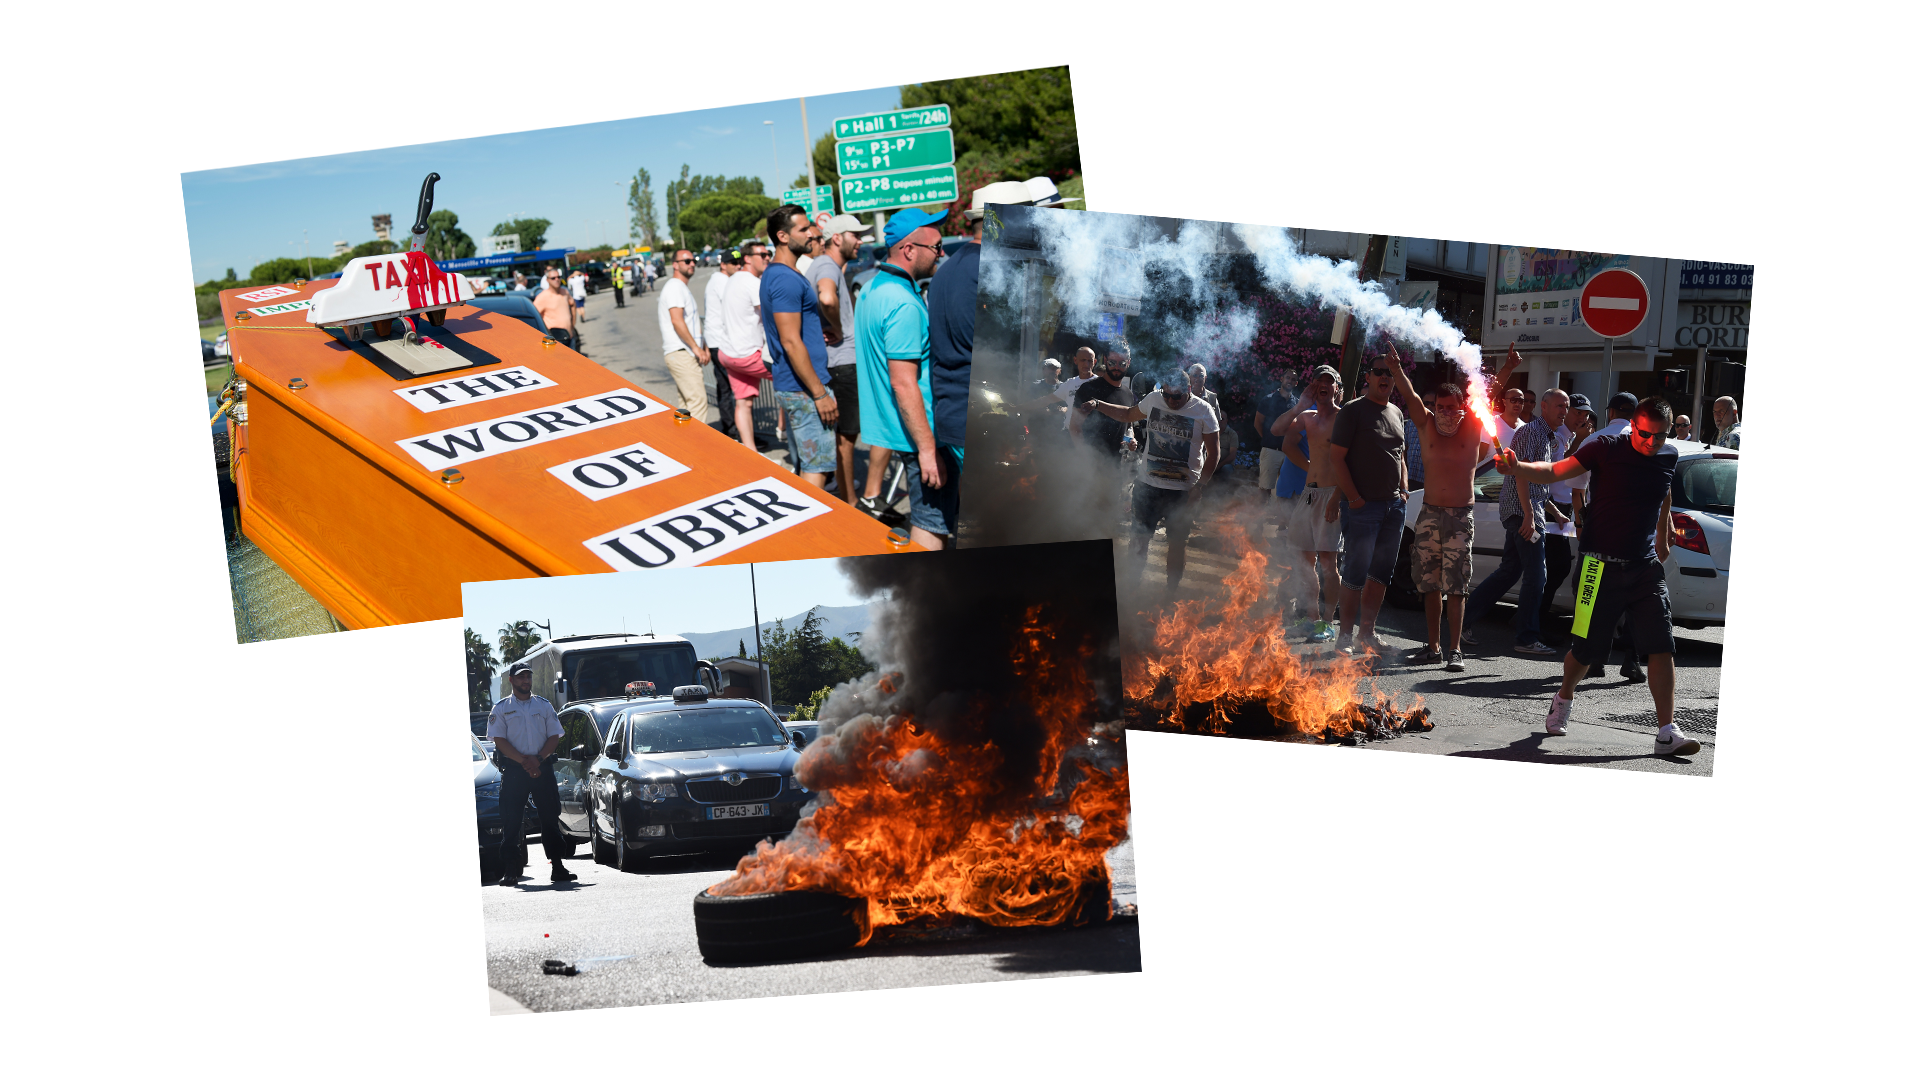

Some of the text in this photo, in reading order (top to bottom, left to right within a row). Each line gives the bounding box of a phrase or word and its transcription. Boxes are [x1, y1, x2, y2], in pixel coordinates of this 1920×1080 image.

[852, 116, 884, 133] Hall
[889, 115, 897, 129] 1
[870, 137, 915, 155] P3-P7
[872, 154, 890, 169] P1
[845, 177, 891, 195] P2-P8
[925, 175, 954, 186] minute
[900, 193, 911, 203] de
[448, 257, 512, 270] Marseille Provence
[365, 256, 429, 292] TAXI
[1692, 274, 1704, 284] 04
[1708, 274, 1720, 284] 91
[1724, 275, 1737, 285] 83
[244, 288, 288, 300] RSI
[408, 370, 542, 405] THE
[411, 395, 647, 460] WORLD
[572, 449, 661, 489] OF
[600, 488, 810, 568] UBER
[1581, 560, 1599, 606] TAXI EN GRÈVE
[681, 687, 704, 696] TAXI
